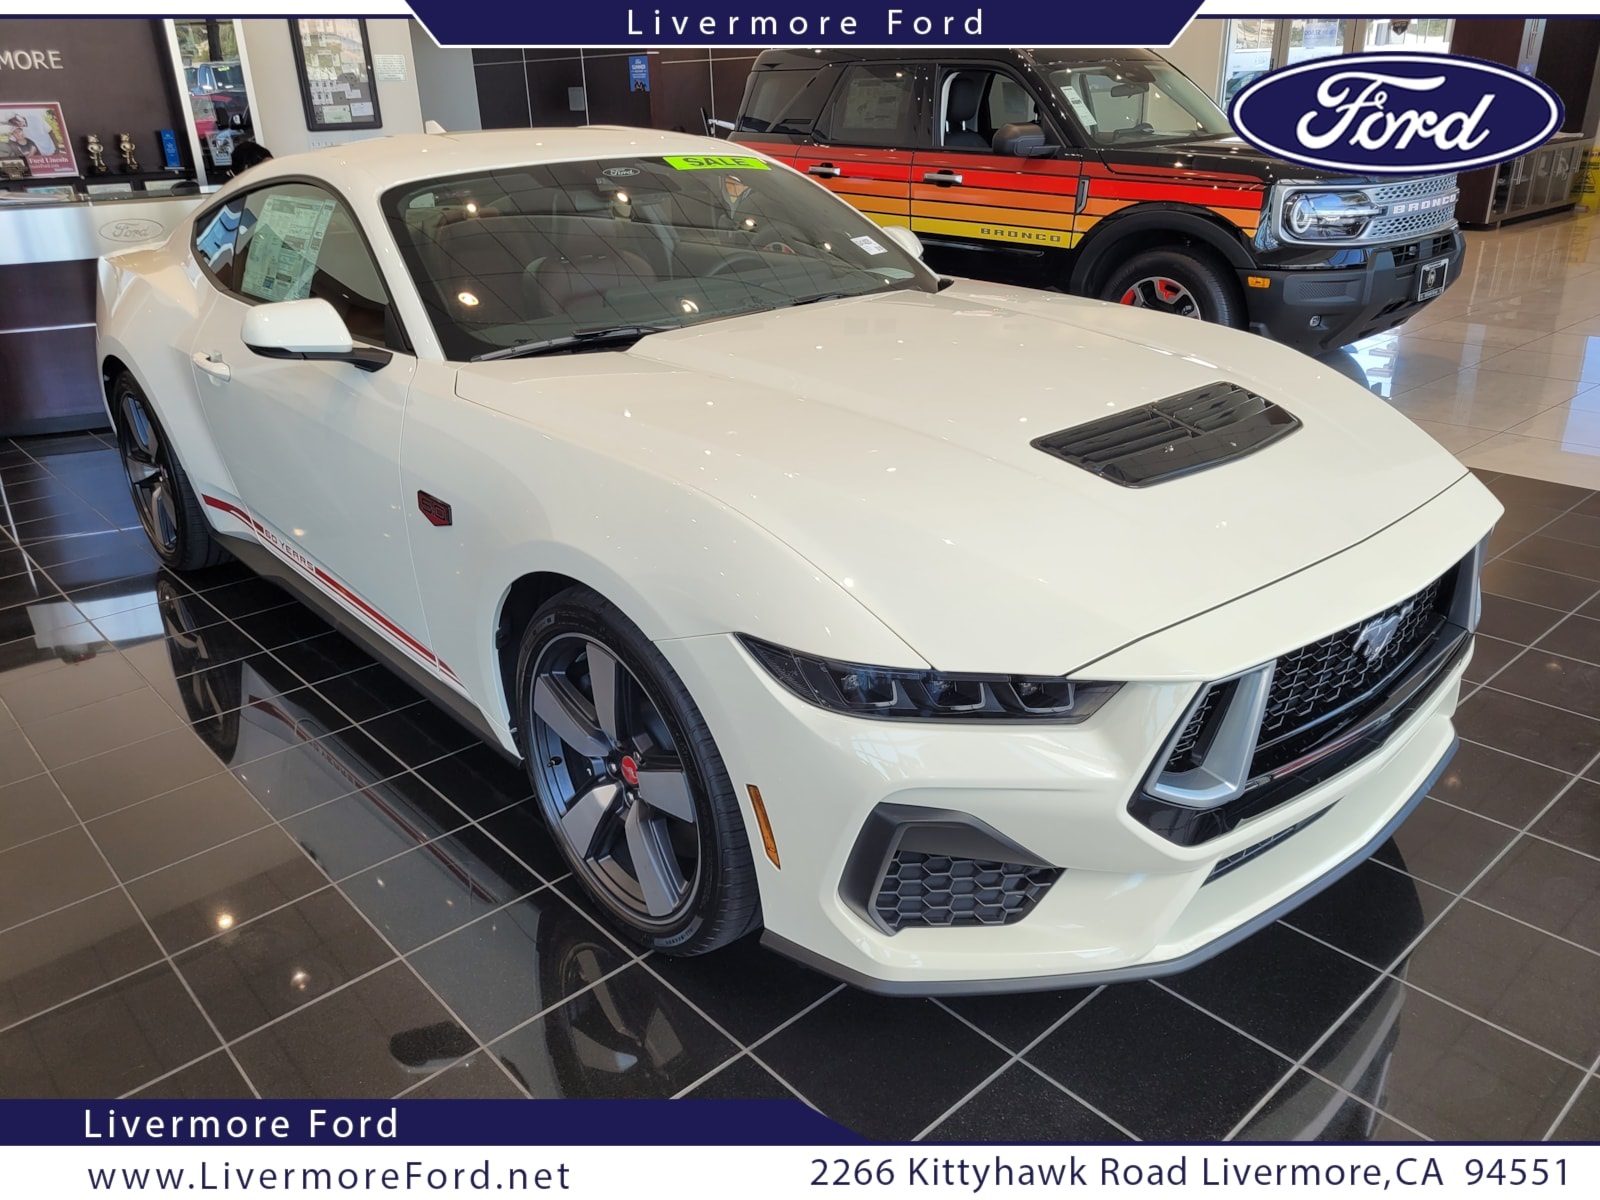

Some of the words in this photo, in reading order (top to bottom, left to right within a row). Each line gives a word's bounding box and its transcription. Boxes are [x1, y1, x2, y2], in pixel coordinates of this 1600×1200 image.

[682, 157, 749, 167] SALE
[1393, 194, 1457, 214] BRONCO
[112, 222, 150, 238] Ford
[980, 228, 1061, 242] BRONCO
[264, 529, 278, 544] 60
[279, 539, 314, 571] YEARS
